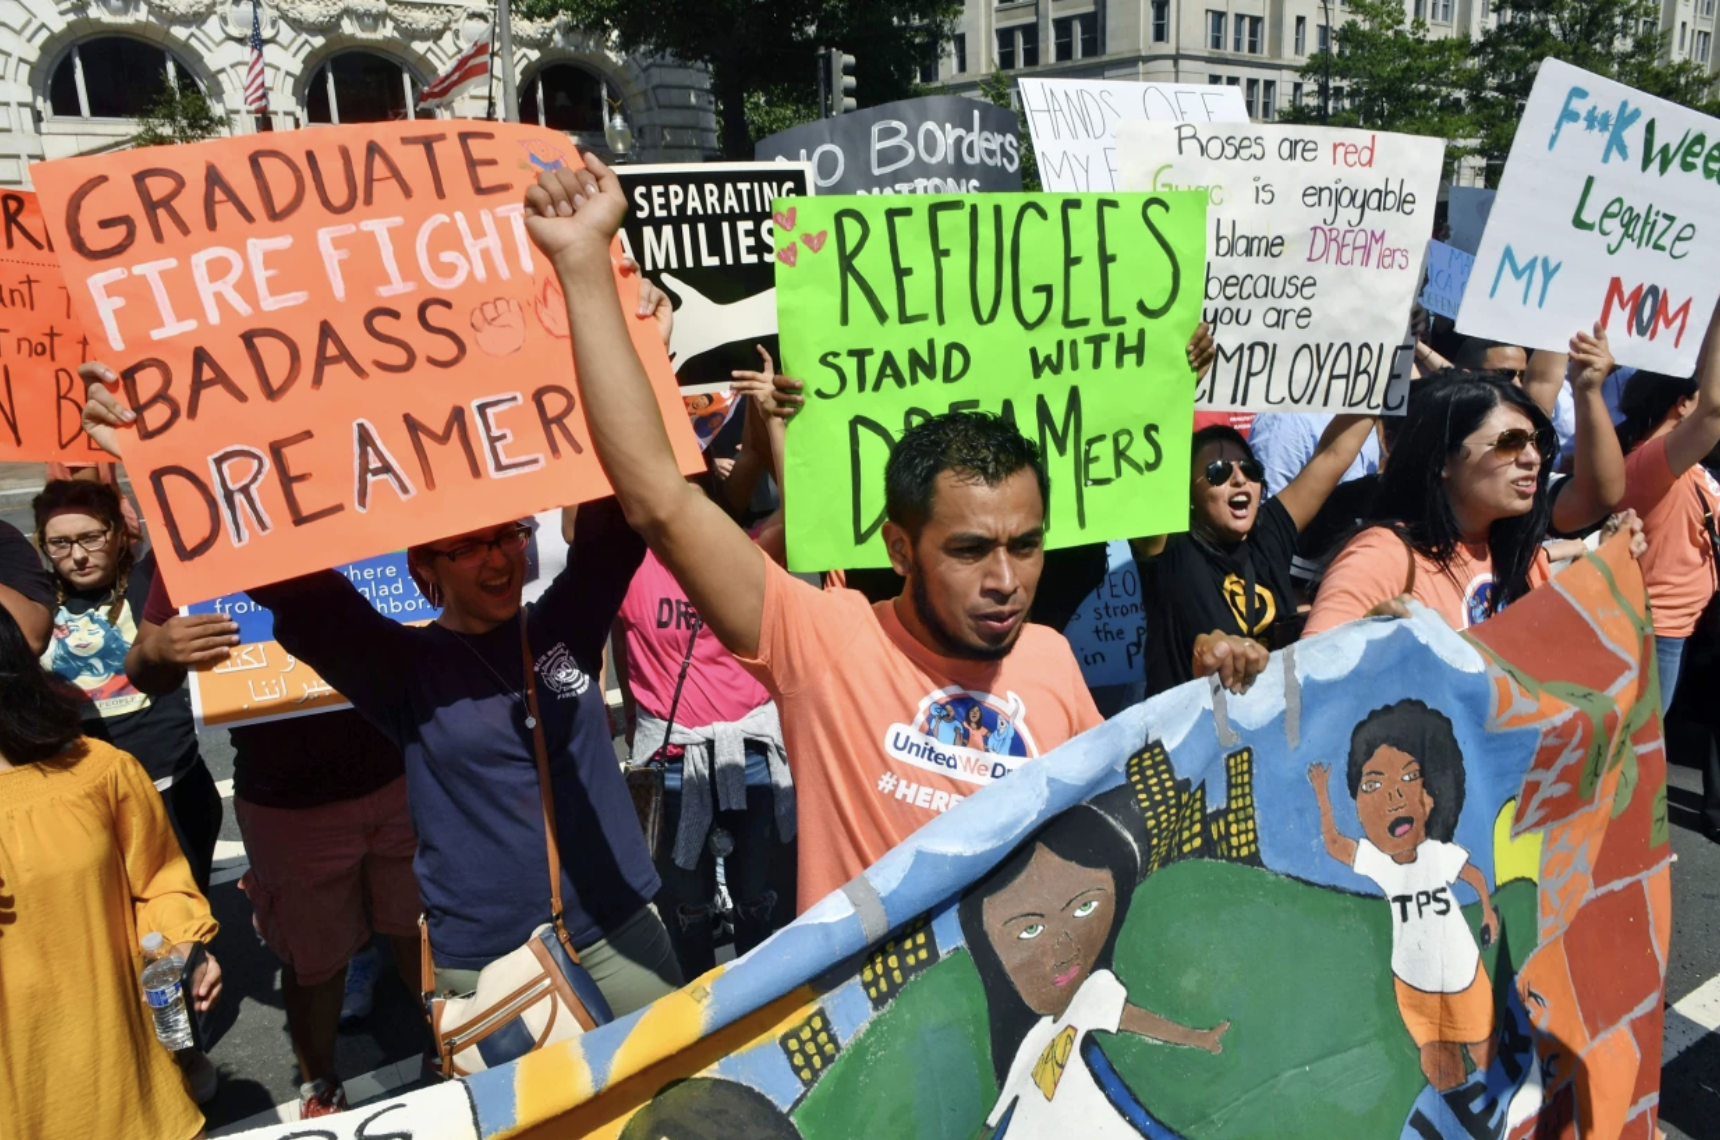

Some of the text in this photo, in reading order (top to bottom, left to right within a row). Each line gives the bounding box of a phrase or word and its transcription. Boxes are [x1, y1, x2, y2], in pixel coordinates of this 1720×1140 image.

[870, 109, 1020, 177] Borders
[1174, 123, 1376, 168] Roses are red
[1641, 118, 1720, 186] Wee
[66, 131, 515, 260] GRADUATE
[1253, 177, 1275, 205] is
[1302, 177, 1416, 227] enjoyable
[1571, 175, 1696, 260] Legalize
[834, 197, 1182, 330] REFUGEES
[1215, 218, 1410, 270] blame DREAMers
[1204, 262, 1317, 301] because
[1488, 243, 1692, 348] MY MOM
[17, 325, 63, 362] not
[1202, 306, 1313, 337] you are
[119, 298, 467, 440] BADASS
[814, 327, 1146, 399] STAND WITH
[149, 384, 584, 562] DREAMER
[849, 385, 1163, 547] DMERS
[344, 564, 397, 582] here
[1391, 887, 1451, 922] TPS
